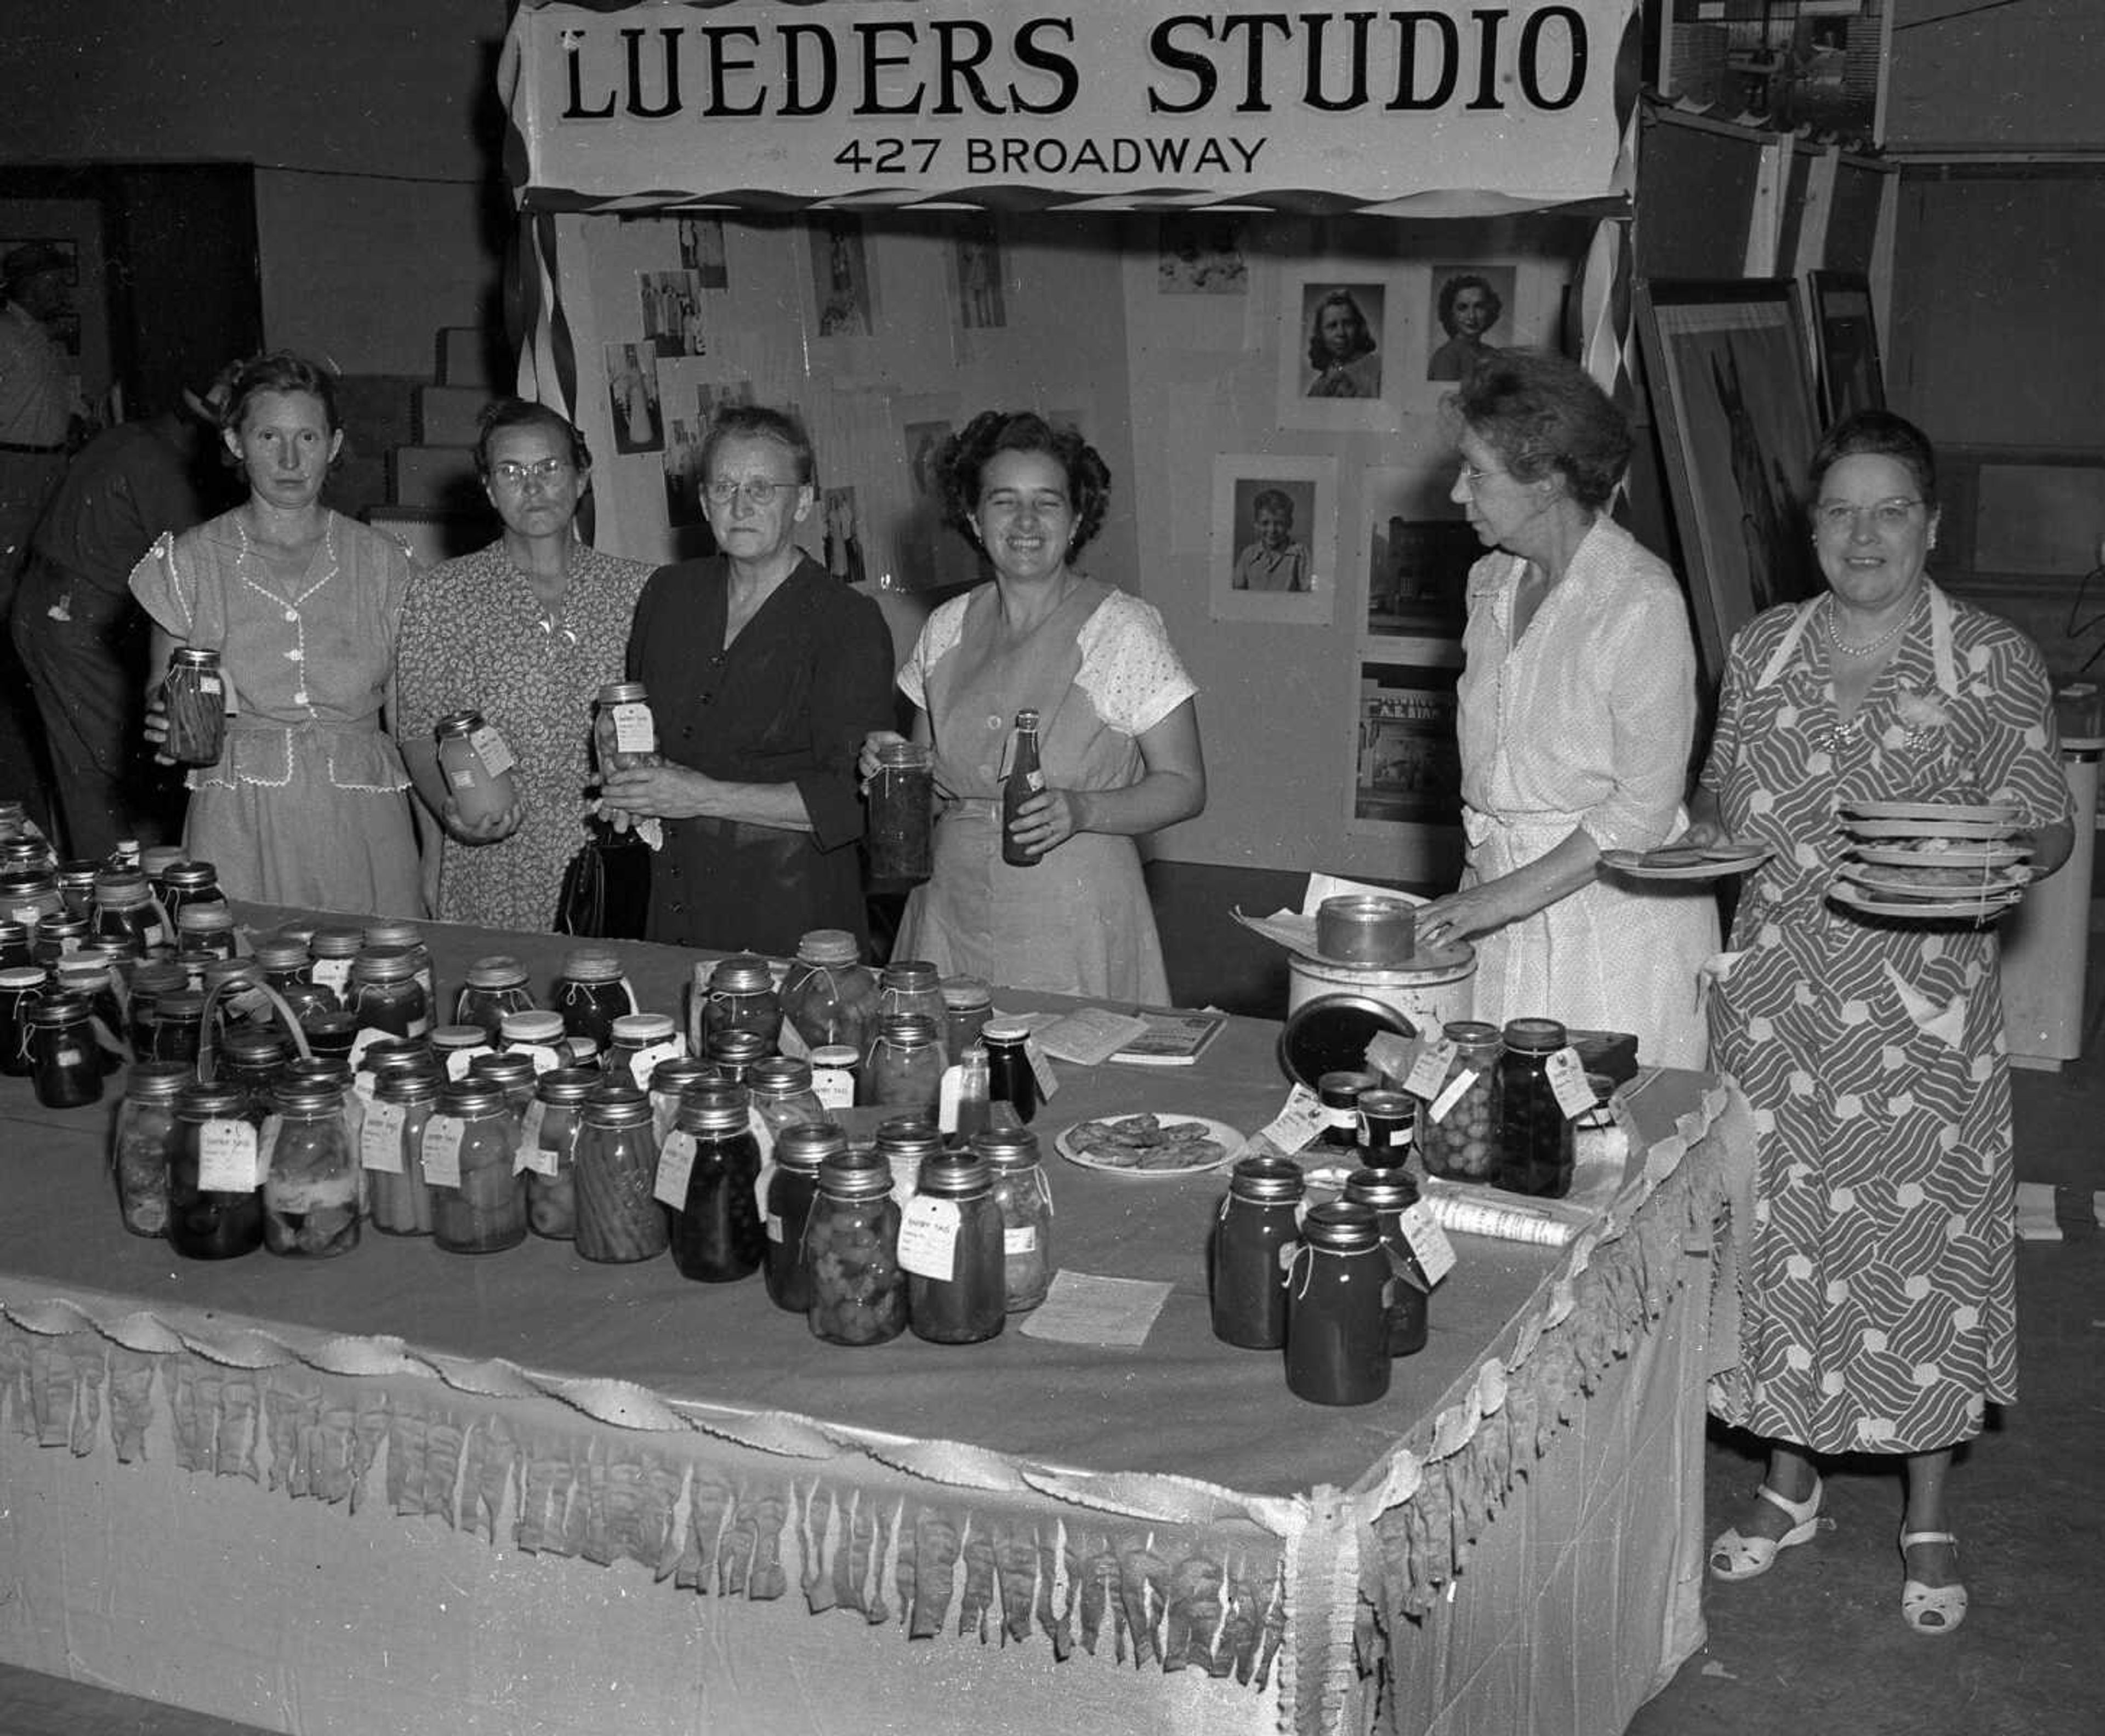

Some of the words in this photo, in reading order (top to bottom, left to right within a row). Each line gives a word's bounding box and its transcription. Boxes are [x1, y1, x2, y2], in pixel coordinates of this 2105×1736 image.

[562, 16, 1079, 119] LUEDERS
[1147, 5, 1589, 113] STUDIO
[833, 138, 942, 174] 427
[966, 137, 1267, 174] BROADWAY
